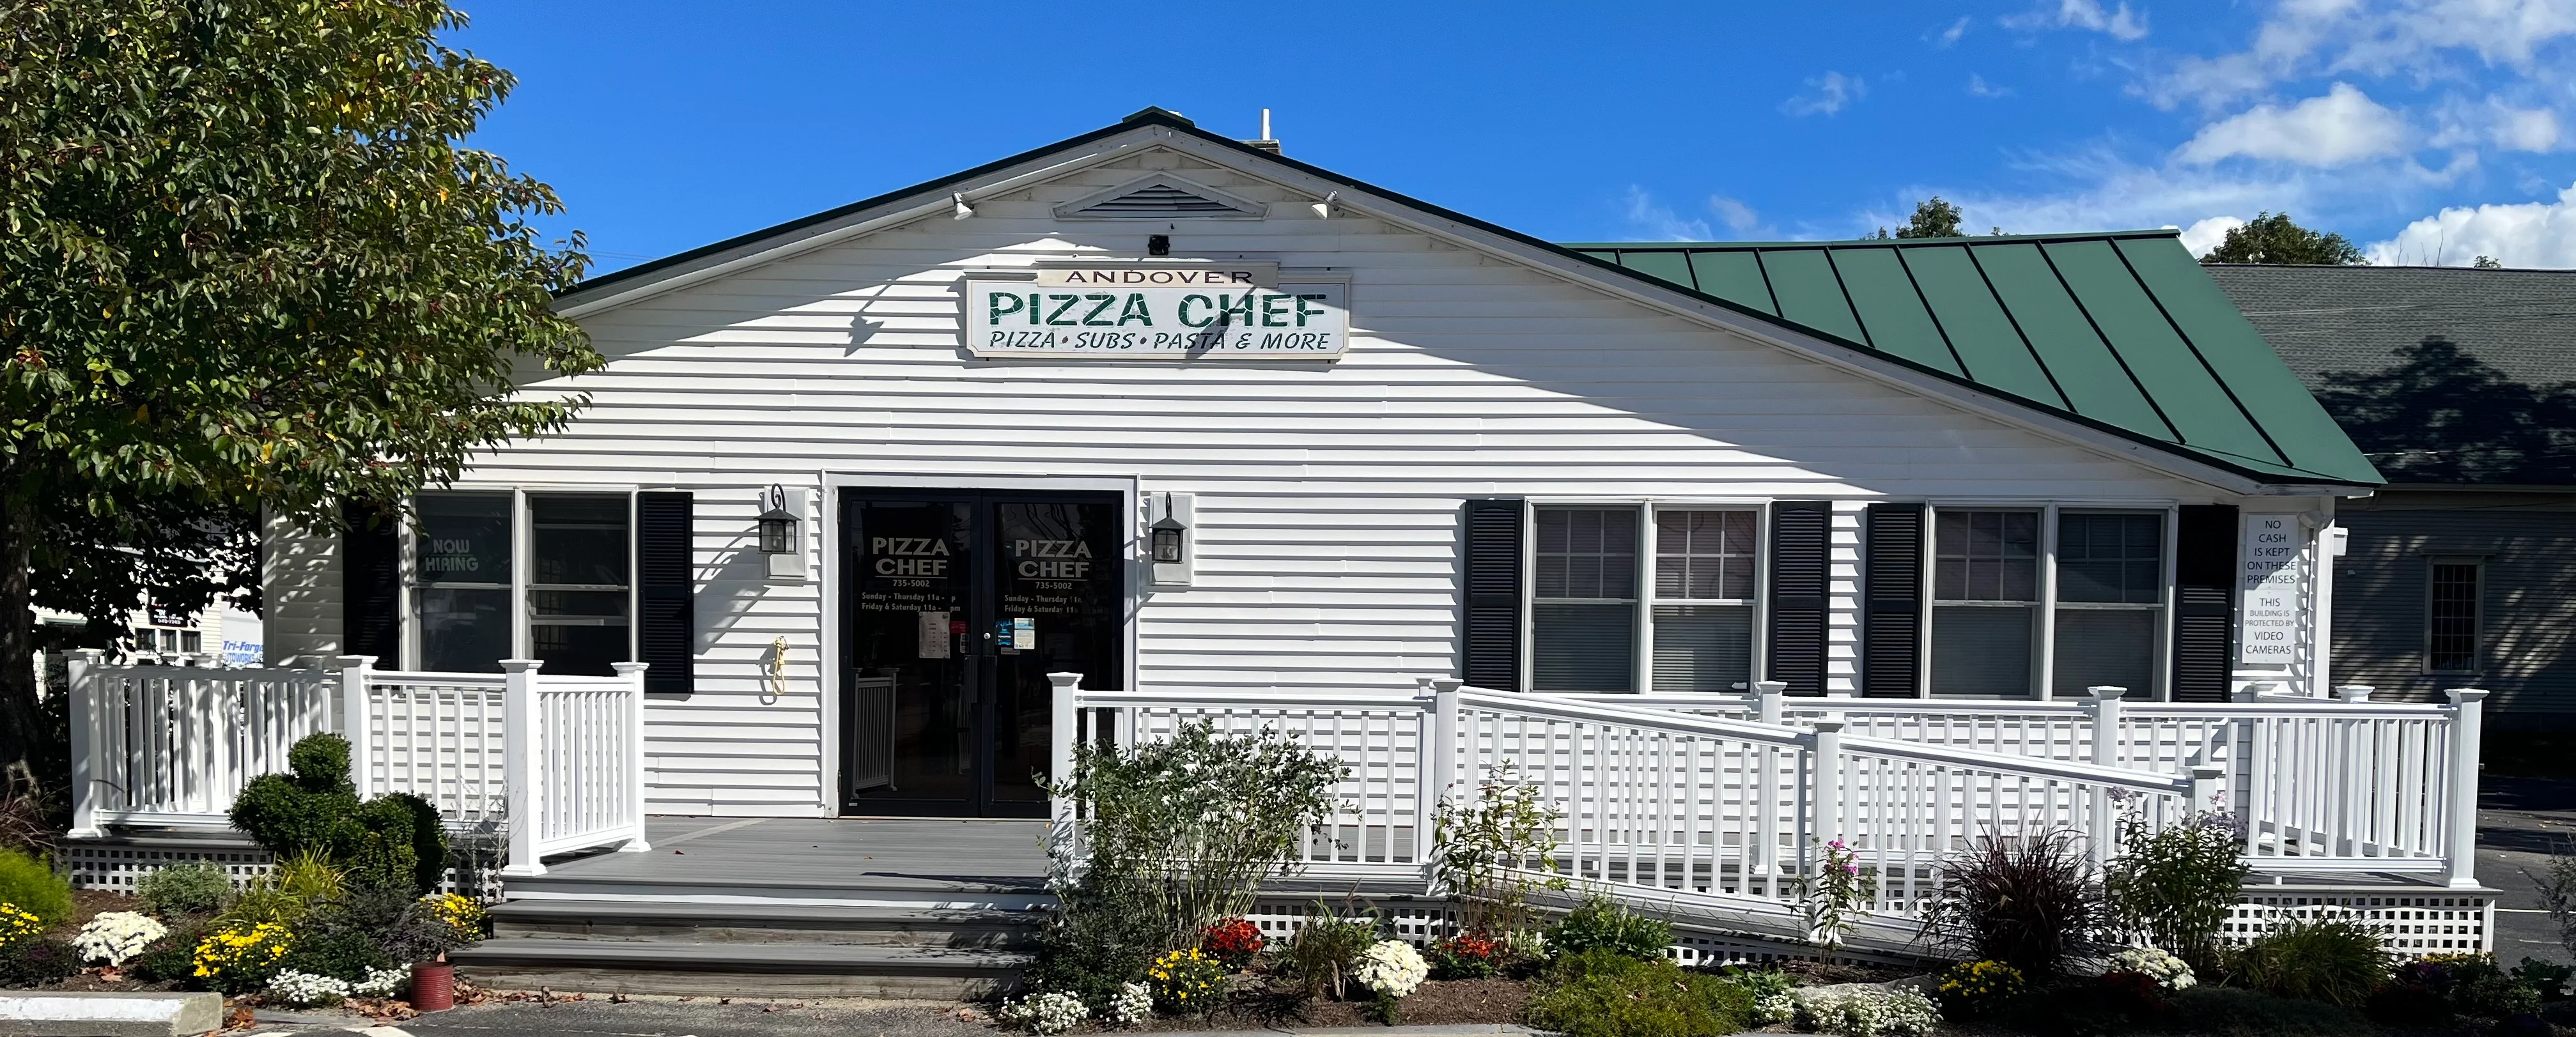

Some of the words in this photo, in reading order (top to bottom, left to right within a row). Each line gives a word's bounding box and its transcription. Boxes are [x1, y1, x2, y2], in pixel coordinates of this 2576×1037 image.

[1065, 271, 1253, 284] ANDOVER
[989, 292, 1153, 326] PIZZA
[1178, 294, 1327, 327] CHEF
[989, 331, 1055, 348] PIZZA
[1075, 332, 1136, 349] SUBS
[1153, 332, 1225, 350] PASTA
[1235, 333, 1252, 350] &
[1260, 332, 1331, 350] MORE
[2265, 520, 2281, 529] NO
[2258, 534, 2286, 542] CASH
[433, 539, 470, 553] NOW
[873, 537, 950, 556] PIZZA
[1016, 539, 1092, 558] PIZZA
[2254, 548, 2263, 557] IS
[2266, 548, 2290, 557] KEPT
[425, 557, 479, 572] HIRING
[876, 558, 947, 575] CHEF
[1018, 560, 1090, 578] CHEF
[2247, 562, 2263, 570] ON
[2265, 561, 2296, 570] THESE
[2247, 575, 2295, 584] PREMISES
[862, 592, 887, 601] Sunday
[894, 593, 925, 602] Thursday
[1004, 595, 1029, 604] Sunday
[1036, 595, 1067, 604] Thursday
[2260, 598, 2280, 606] THIS
[862, 603, 883, 611] Friday
[891, 603, 921, 612] Saturday
[1004, 605, 1025, 613] Friday
[1034, 606, 1064, 614] Saturday
[2254, 632, 2283, 640] VIDEO
[2246, 645, 2291, 654] CAMERAS
